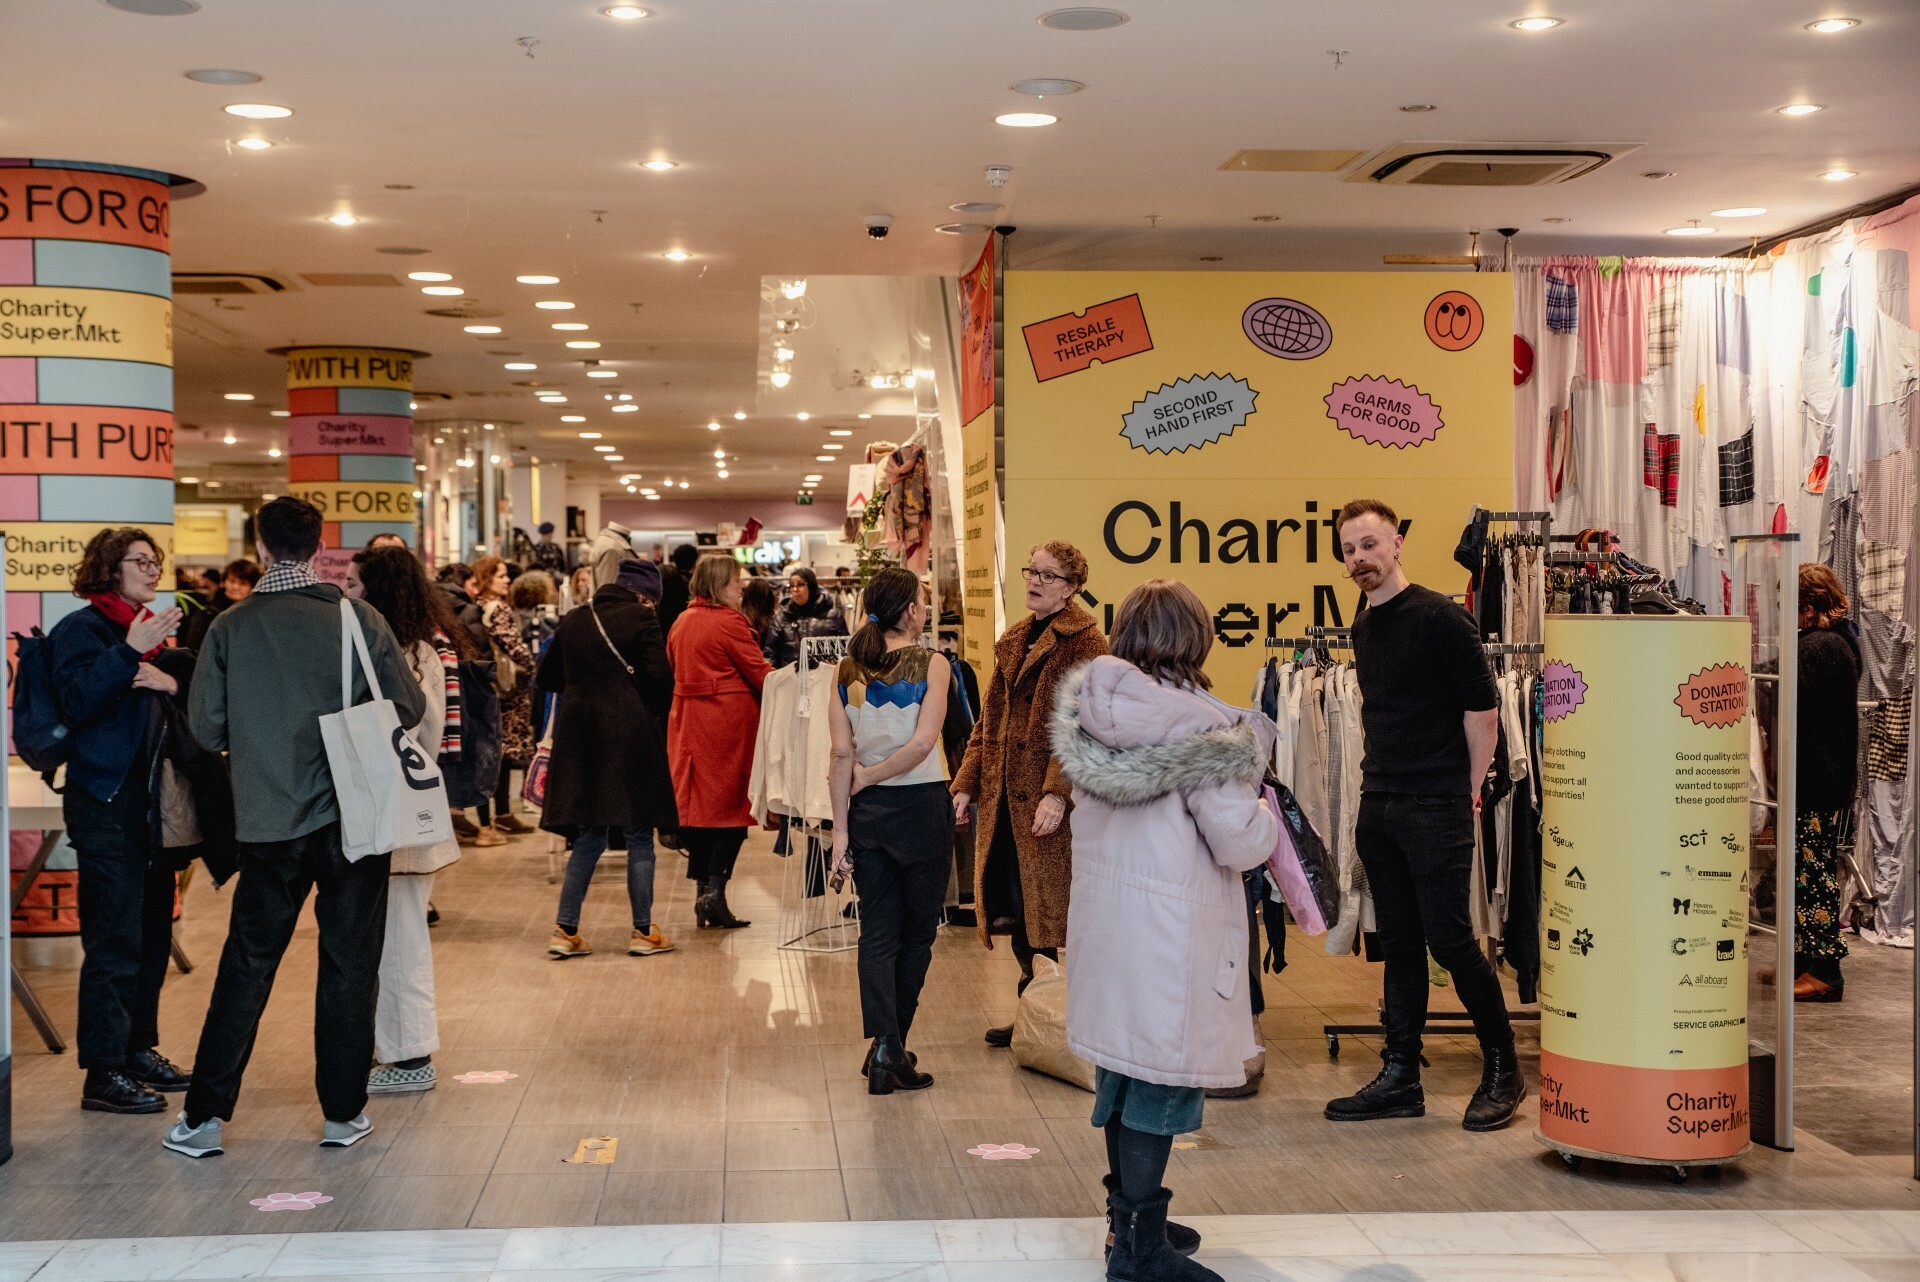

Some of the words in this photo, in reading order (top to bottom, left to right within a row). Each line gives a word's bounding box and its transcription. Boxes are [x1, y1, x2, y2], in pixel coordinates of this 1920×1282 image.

[26, 185, 128, 229] FOR
[0, 299, 87, 322] Charity
[0, 322, 121, 344] Super.Mkt
[1056, 317, 1116, 346] RESALE
[1053, 330, 1125, 362] THERAPY
[293, 357, 359, 380] WITH
[1153, 391, 1218, 420] SECOND
[1354, 391, 1412, 416] GARMS
[1145, 416, 1190, 440] HAND
[1192, 400, 1234, 424] FIRST
[1341, 403, 1372, 422] FOR
[1375, 412, 1420, 434] GOOD
[336, 491, 392, 513] FOR
[1102, 500, 1413, 564] Charit
[1691, 681, 1747, 700] DONATION
[1700, 696, 1744, 713] STATION
[1556, 748, 1586, 760] clothing
[1675, 752, 1701, 761] Good
[1703, 752, 1731, 763] quality
[1675, 766, 1694, 775] and
[1695, 766, 1741, 775] accessories
[1577, 777, 1586, 786] all
[1675, 781, 1711, 790] wanted
[1713, 782, 1722, 790] to
[1675, 795, 1703, 804] these
[1704, 795, 1725, 806] good
[1698, 870, 1732, 878] emmaus
[1564, 879, 1587, 891] SHELTER
[1717, 949, 1734, 960] traid
[1695, 974, 1704, 984] all
[1704, 975, 1728, 985] aboard
[1673, 1021, 1707, 1030] SERVICE
[1709, 1018, 1740, 1029] GRAPHICS
[1666, 1091, 1737, 1112] Charity
[1666, 1109, 1749, 1139] Super.Mkt
